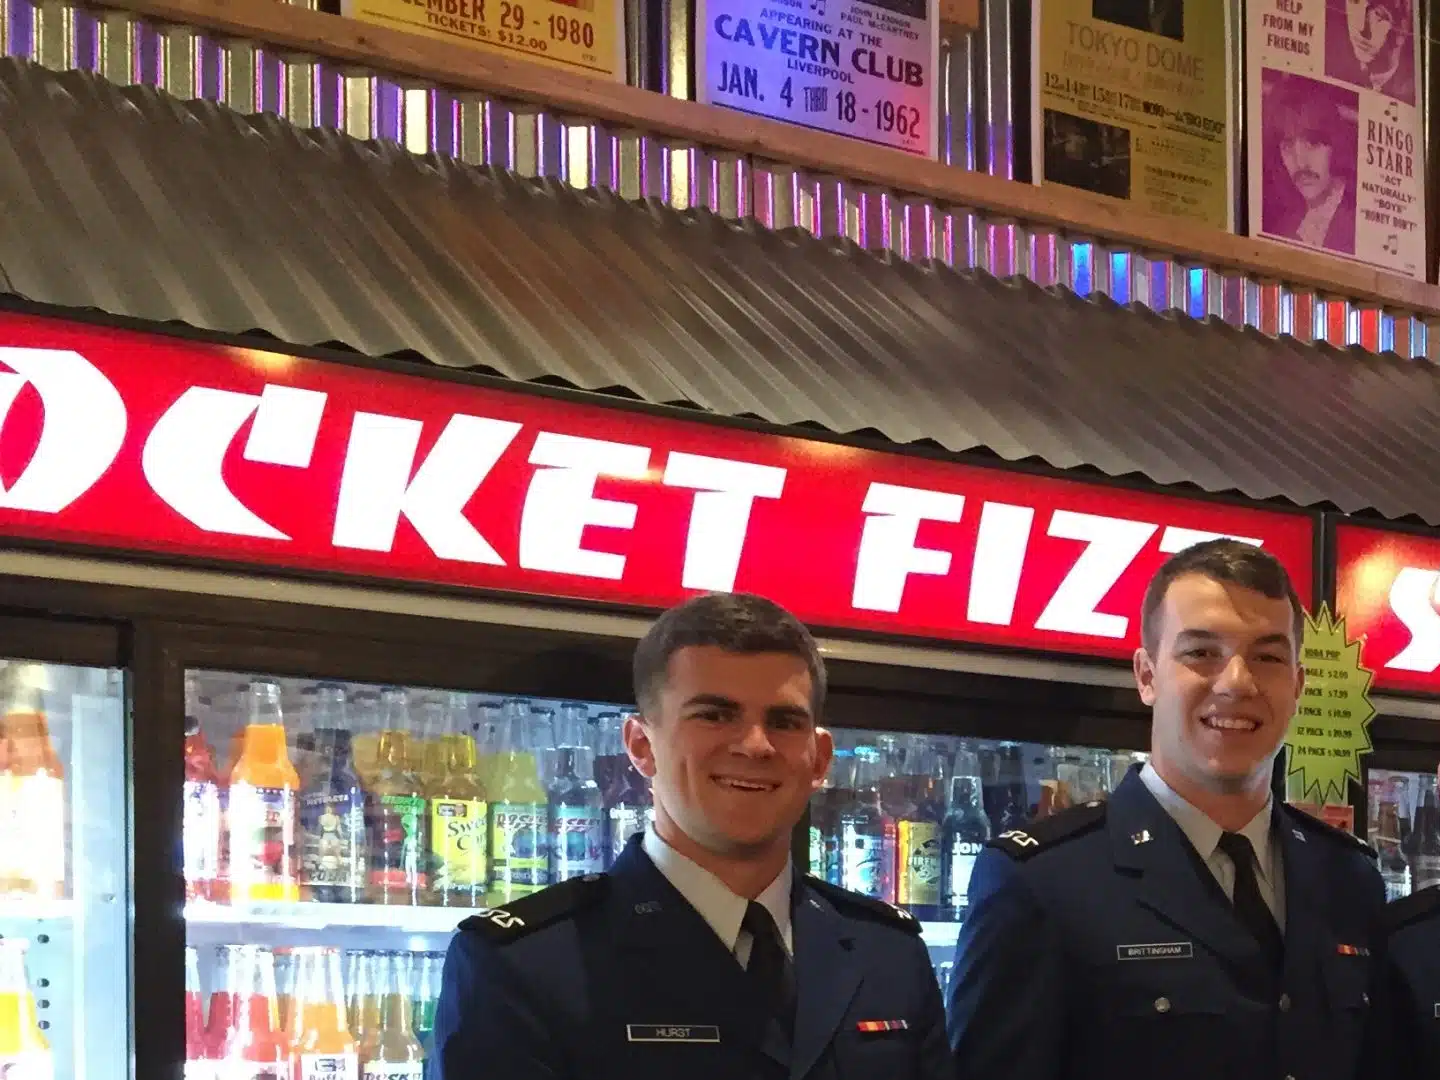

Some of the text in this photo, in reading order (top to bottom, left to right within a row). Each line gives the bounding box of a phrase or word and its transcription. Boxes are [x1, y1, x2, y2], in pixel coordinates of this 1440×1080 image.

[404, 0, 594, 48] MBER 29 1980
[425, 12, 547, 51] TICKETS: $12.00
[760, 8, 883, 49] APPEARING AT THE
[841, 12, 864, 26] PAUL
[1263, 13, 1314, 37] FROM MY
[714, 13, 924, 88] CAVERN CLUB
[1066, 20, 1141, 63] TOKYO
[1266, 33, 1310, 56] FRIENDS
[787, 57, 855, 85] LIVERPOOL
[717, 61, 921, 140] JAN. 4 THRU 18 1962
[1367, 119, 1413, 154] RINGO
[1366, 144, 1413, 178] STARR
[0, 347, 787, 594] OCKET
[1304, 686, 1323, 697] PACK
[1304, 706, 1322, 716] PACK
[1306, 727, 1324, 737] PACK
[1308, 745, 1326, 757] PACK
[952, 842, 983, 854] JON
[656, 1028, 691, 1038] HURST
